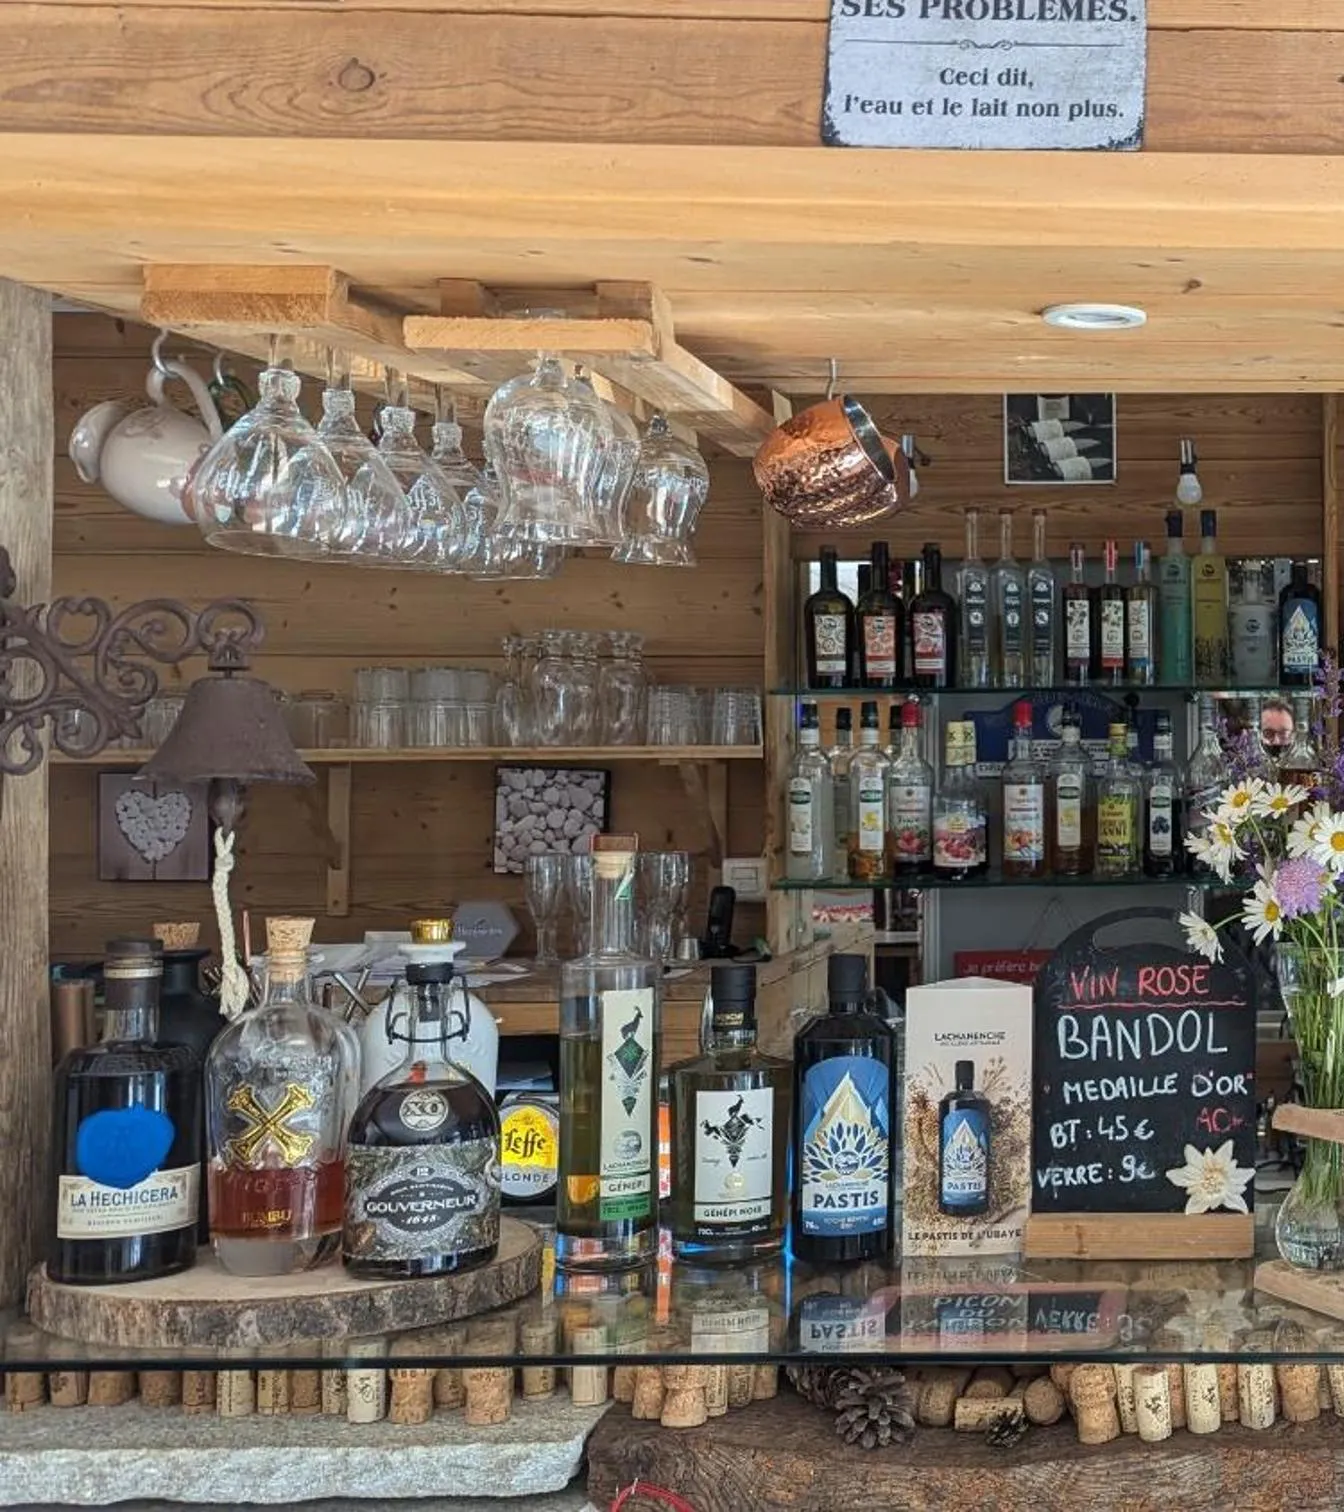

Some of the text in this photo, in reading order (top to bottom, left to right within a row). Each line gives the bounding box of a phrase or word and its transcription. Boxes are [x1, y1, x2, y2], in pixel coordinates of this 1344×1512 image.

[841, 0, 906, 18] SES
[939, 67, 1034, 89] Ceci dit,
[844, 95, 1124, 122] l'eau et le lait non plus.
[1070, 964, 1210, 999] VIN ROSE
[1057, 1009, 1228, 1061] BANDOL
[1063, 1073, 1178, 1104] MEDAILLE
[404, 1101, 443, 1116] XO
[504, 1128, 547, 1159] Leffe
[500, 1172, 549, 1183] LONDE
[71, 1193, 86, 1207] LA
[91, 1186, 178, 1207] HECHICERA
[366, 1194, 477, 1213] GOUVERNEUR
[813, 1190, 879, 1208] PASTIS
[908, 1231, 920, 1240] LE
[922, 1231, 958, 1241] PASTIS
[961, 1232, 974, 1240] DE
[933, 1294, 1023, 1308] PICON
[959, 1308, 996, 1318] DU
